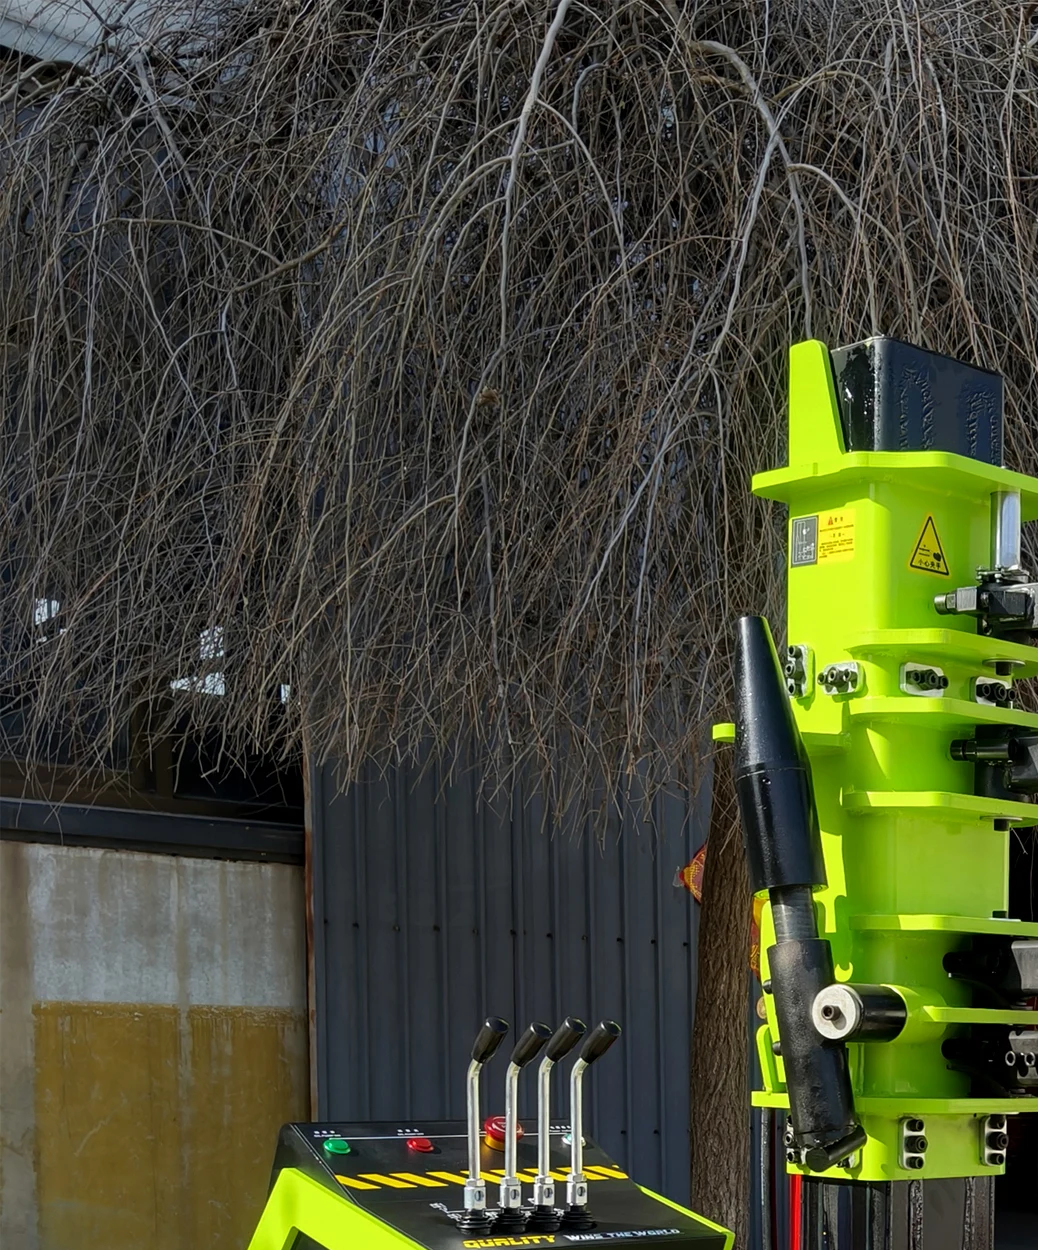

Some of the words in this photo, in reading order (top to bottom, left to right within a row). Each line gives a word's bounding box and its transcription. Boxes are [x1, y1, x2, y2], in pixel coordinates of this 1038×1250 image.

[462, 1235, 556, 1248] QUALITY
[563, 1233, 603, 1241] WINS
[632, 1228, 680, 1236] WORLD
